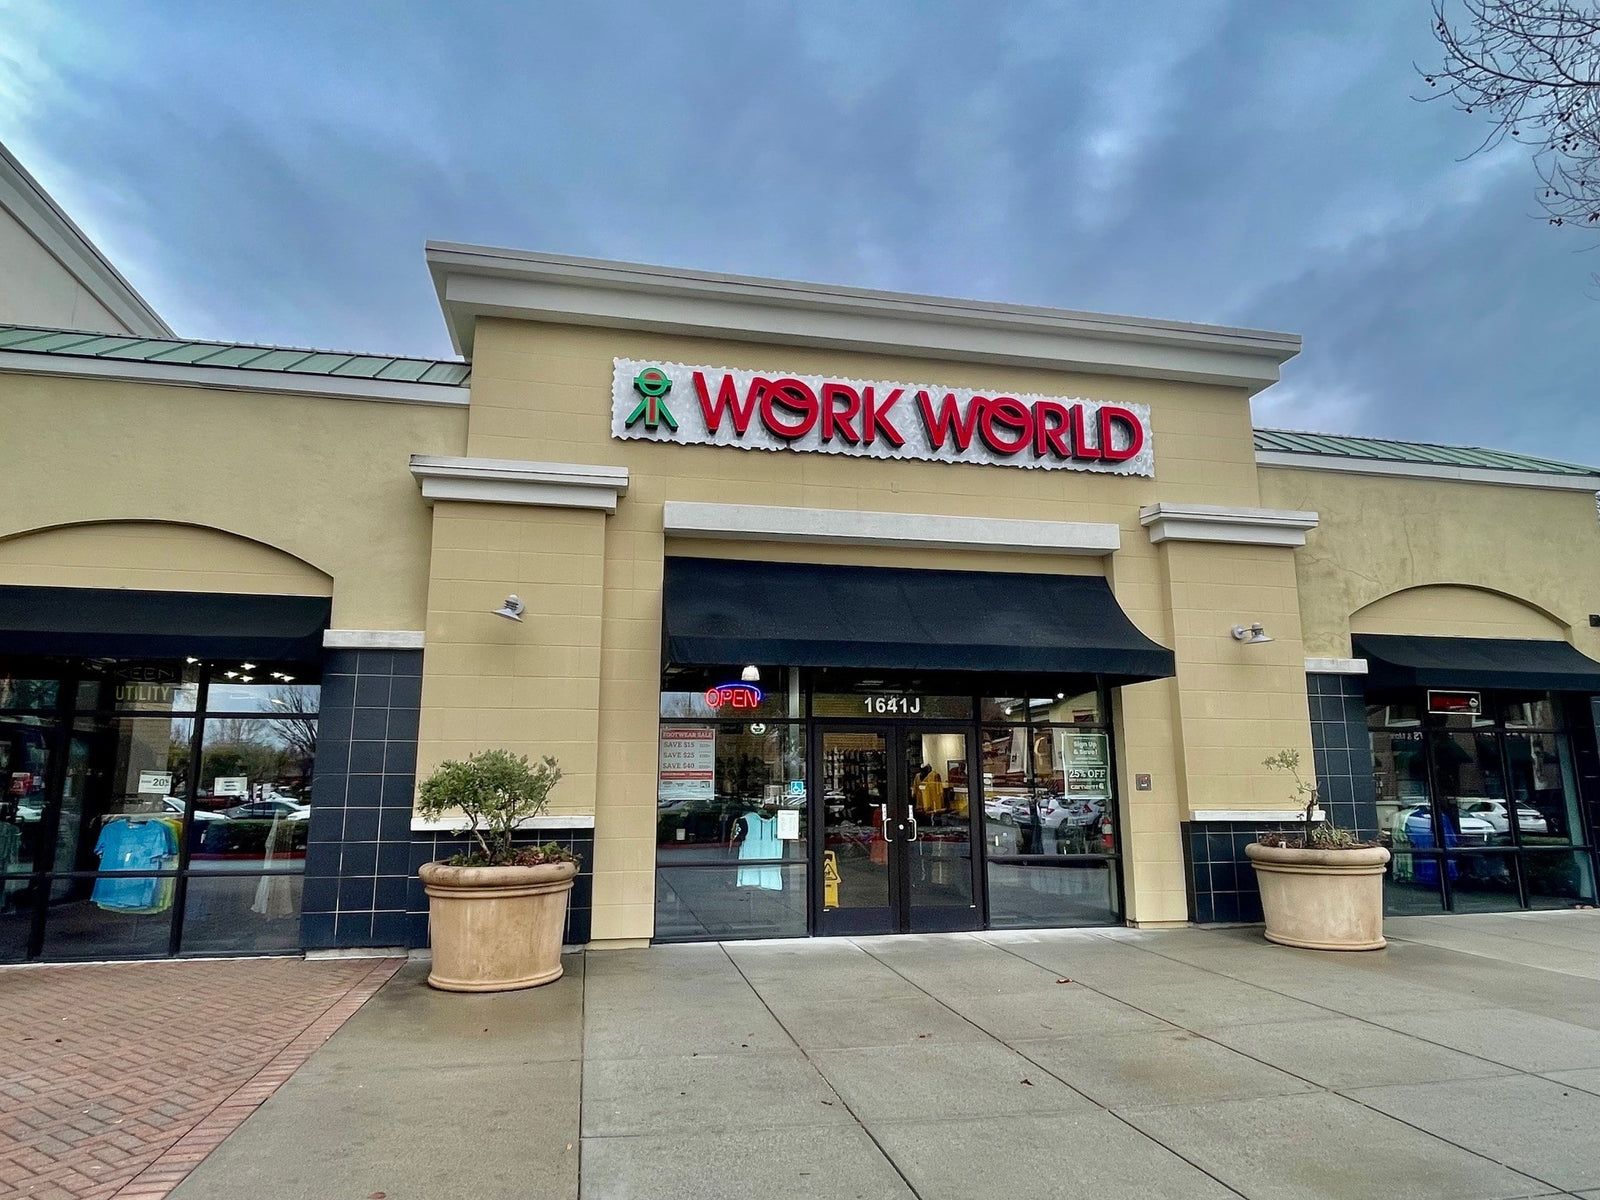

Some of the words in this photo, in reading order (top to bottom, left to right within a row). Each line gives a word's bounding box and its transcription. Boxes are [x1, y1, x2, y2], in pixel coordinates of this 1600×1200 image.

[692, 371, 904, 447] WORK
[915, 390, 1144, 463] WORLD
[115, 685, 170, 700] UTILITY
[705, 687, 758, 708] OPEN
[864, 696, 921, 714] 1641J
[1069, 769, 1087, 778] 25%
[1087, 769, 1106, 778] OFF
